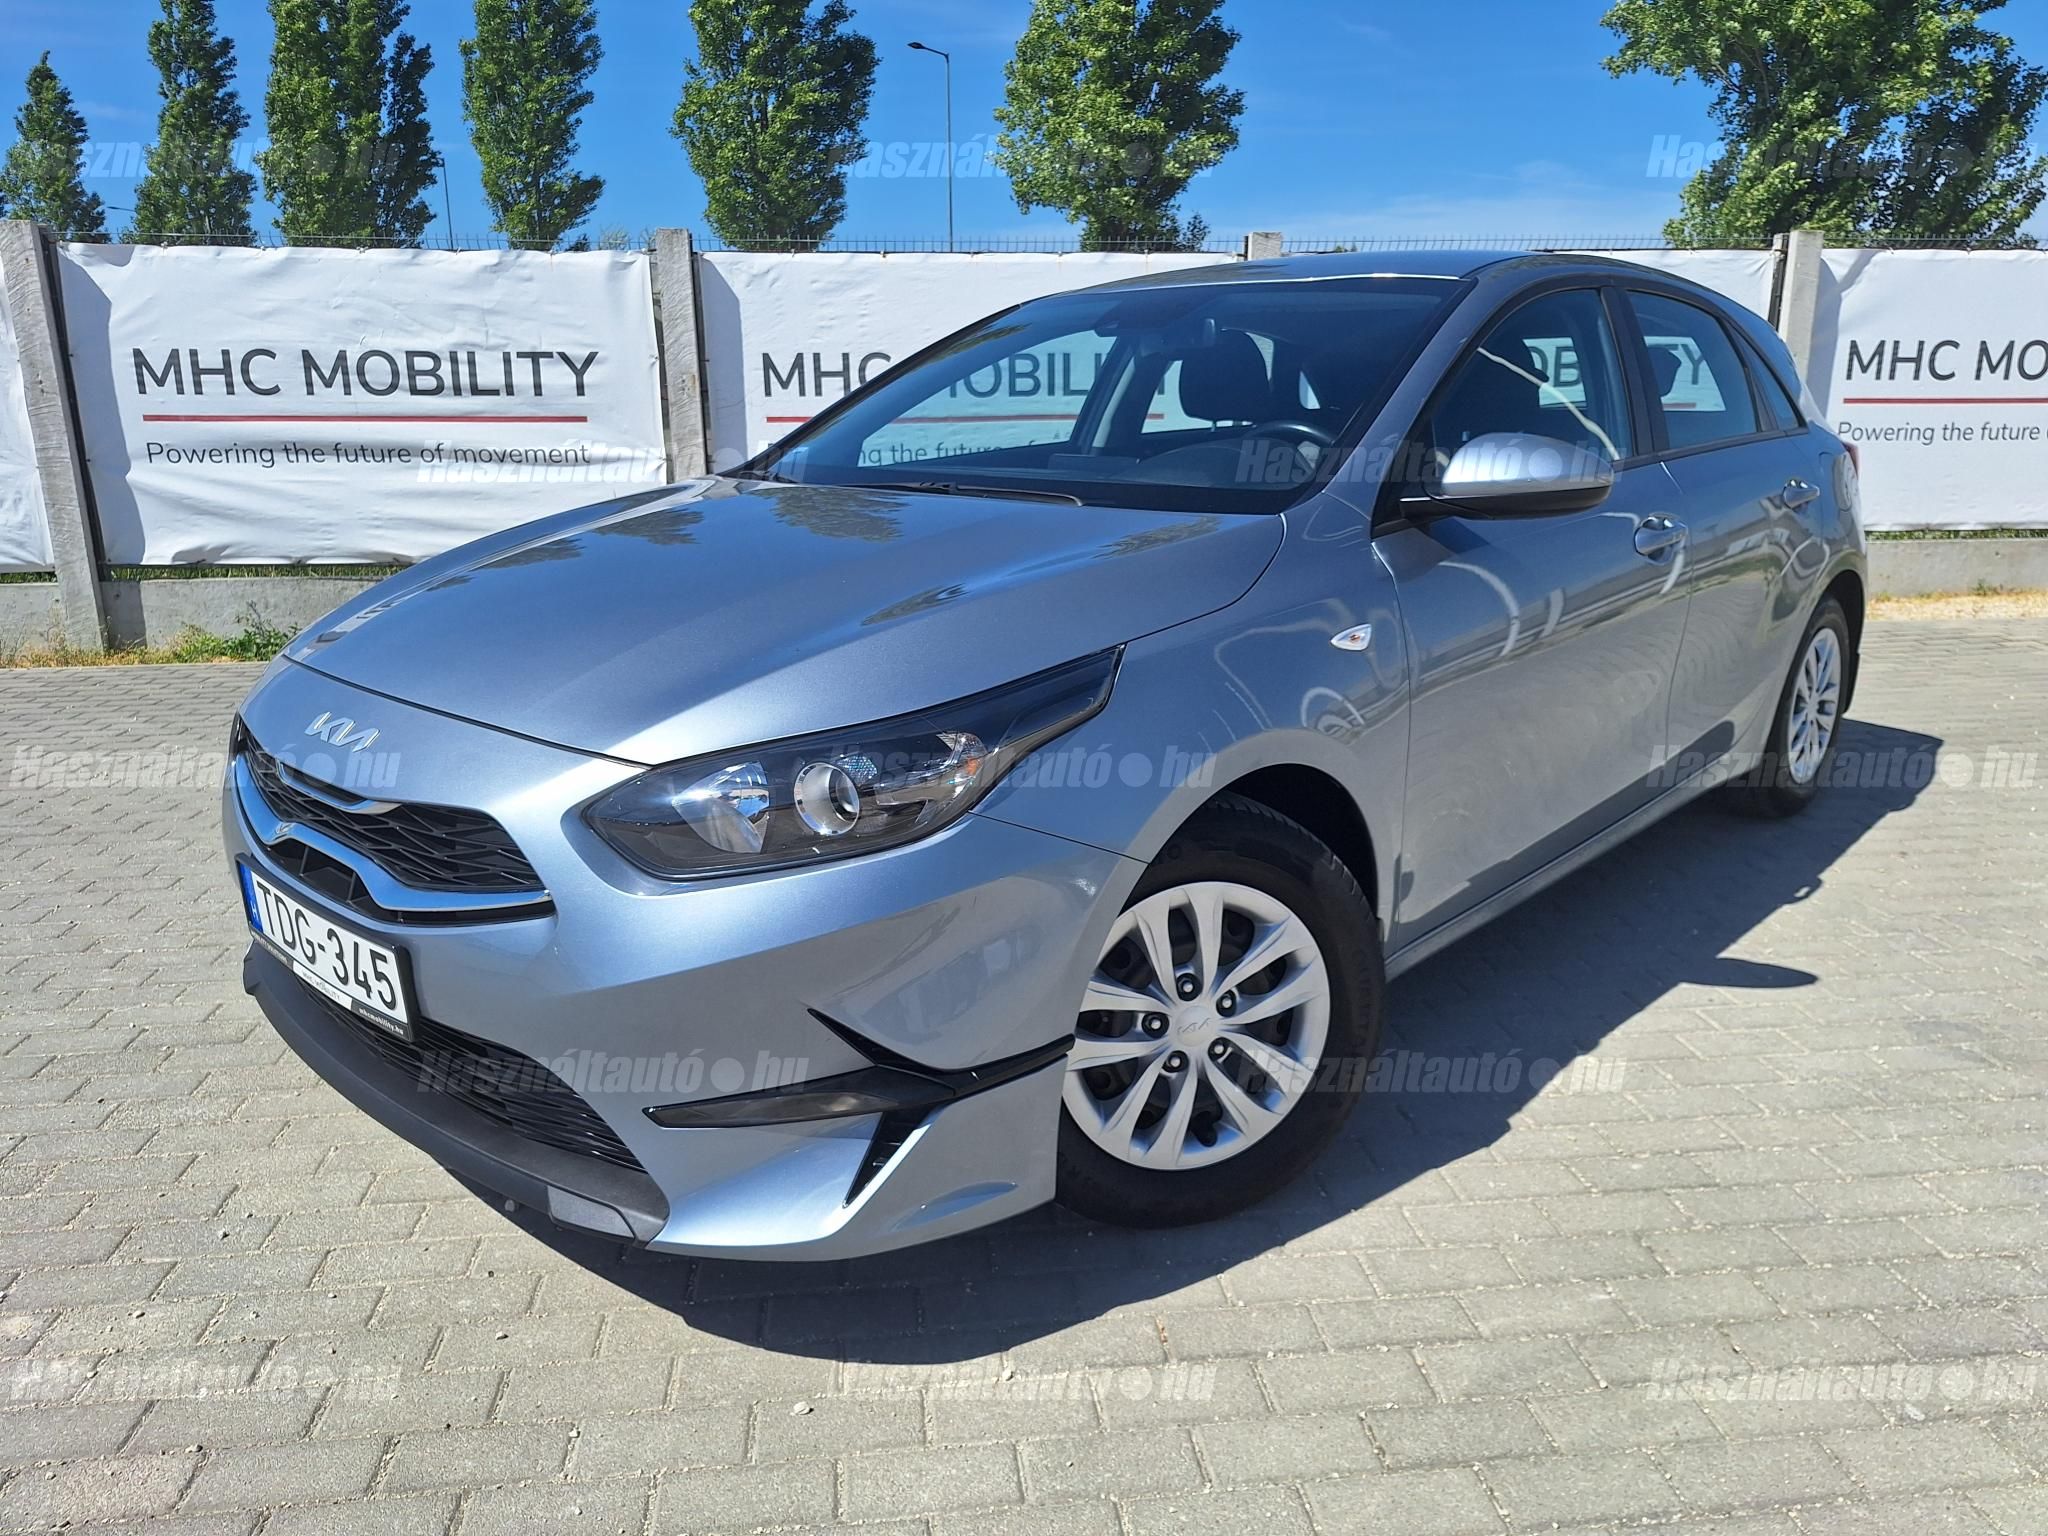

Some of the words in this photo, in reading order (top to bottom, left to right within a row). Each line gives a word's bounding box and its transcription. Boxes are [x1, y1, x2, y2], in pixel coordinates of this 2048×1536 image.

[132, 348, 281, 396] MHC
[302, 349, 599, 397] MOBILITY
[1846, 339, 1960, 381] MHC
[146, 442, 275, 468] Powering
[283, 442, 326, 464] the
[333, 441, 412, 464] future
[420, 441, 446, 464] of
[453, 443, 591, 465] movement
[1838, 421, 1935, 446] Powering
[1941, 421, 1974, 441] the
[1980, 421, 2041, 441] future
[304, 711, 380, 753] KIA
[256, 880, 397, 1011] TDG-345
